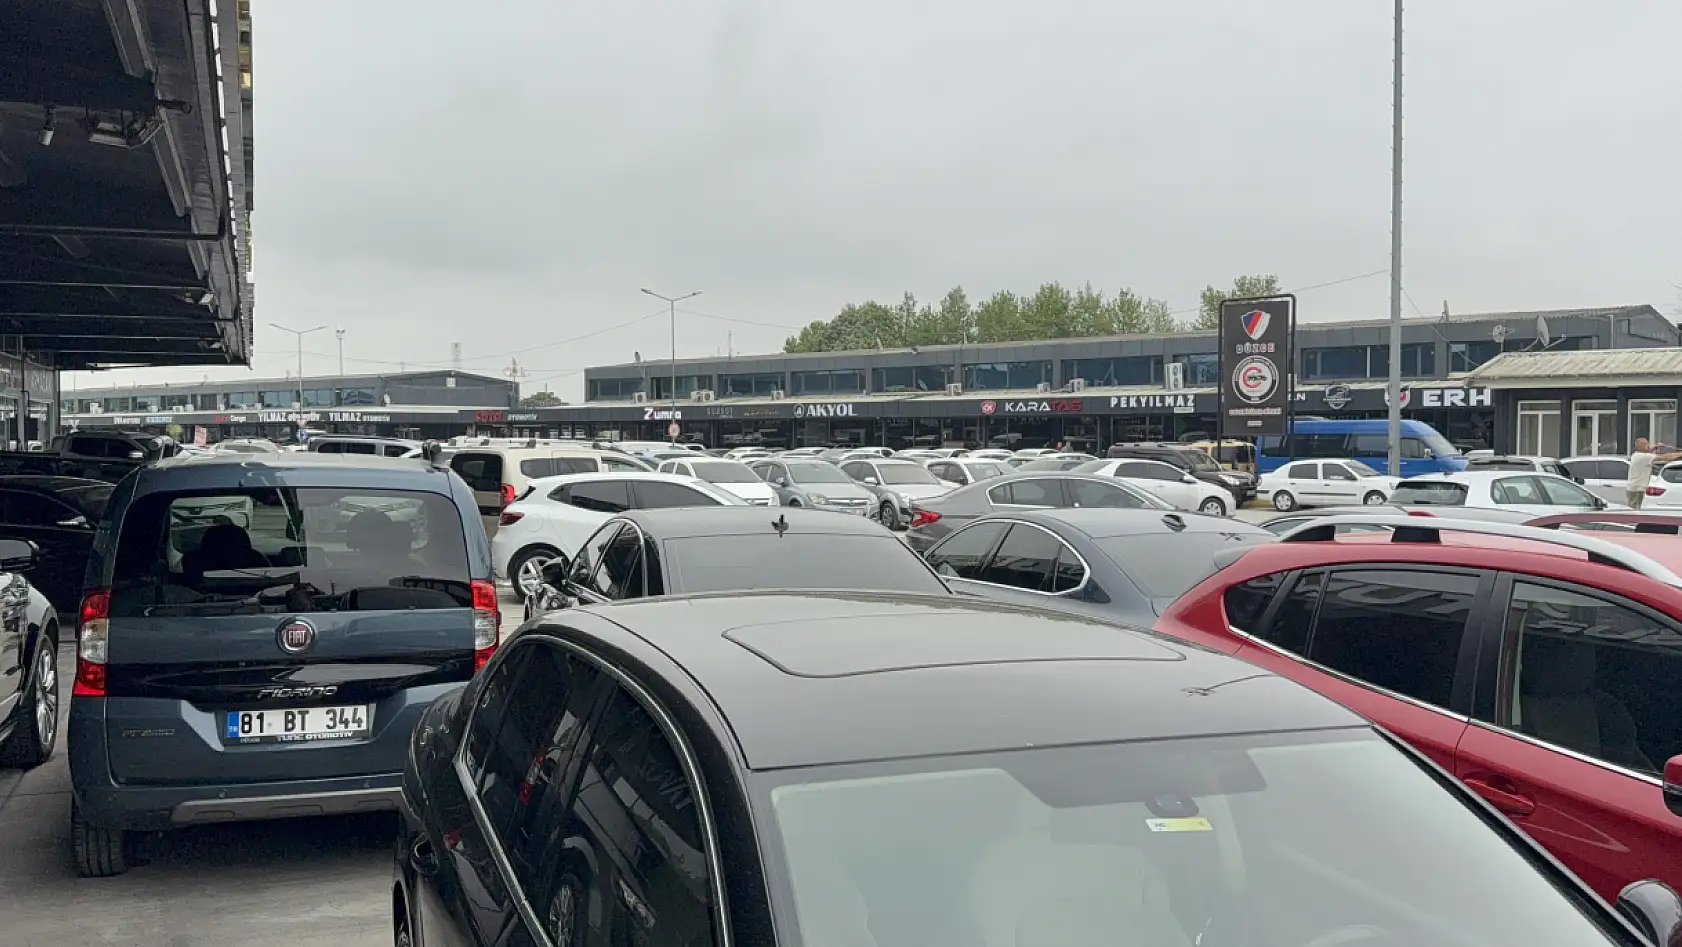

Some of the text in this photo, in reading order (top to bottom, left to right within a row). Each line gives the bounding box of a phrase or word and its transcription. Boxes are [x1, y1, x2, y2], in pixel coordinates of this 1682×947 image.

[1109, 395, 1196, 408] PEKYILMAZ
[258, 411, 287, 422] YILMAZ
[806, 403, 858, 417] AKYOL
[329, 412, 361, 422] YILMAZ
[288, 630, 307, 644] FIAT
[241, 707, 363, 734] 81 BT 344
